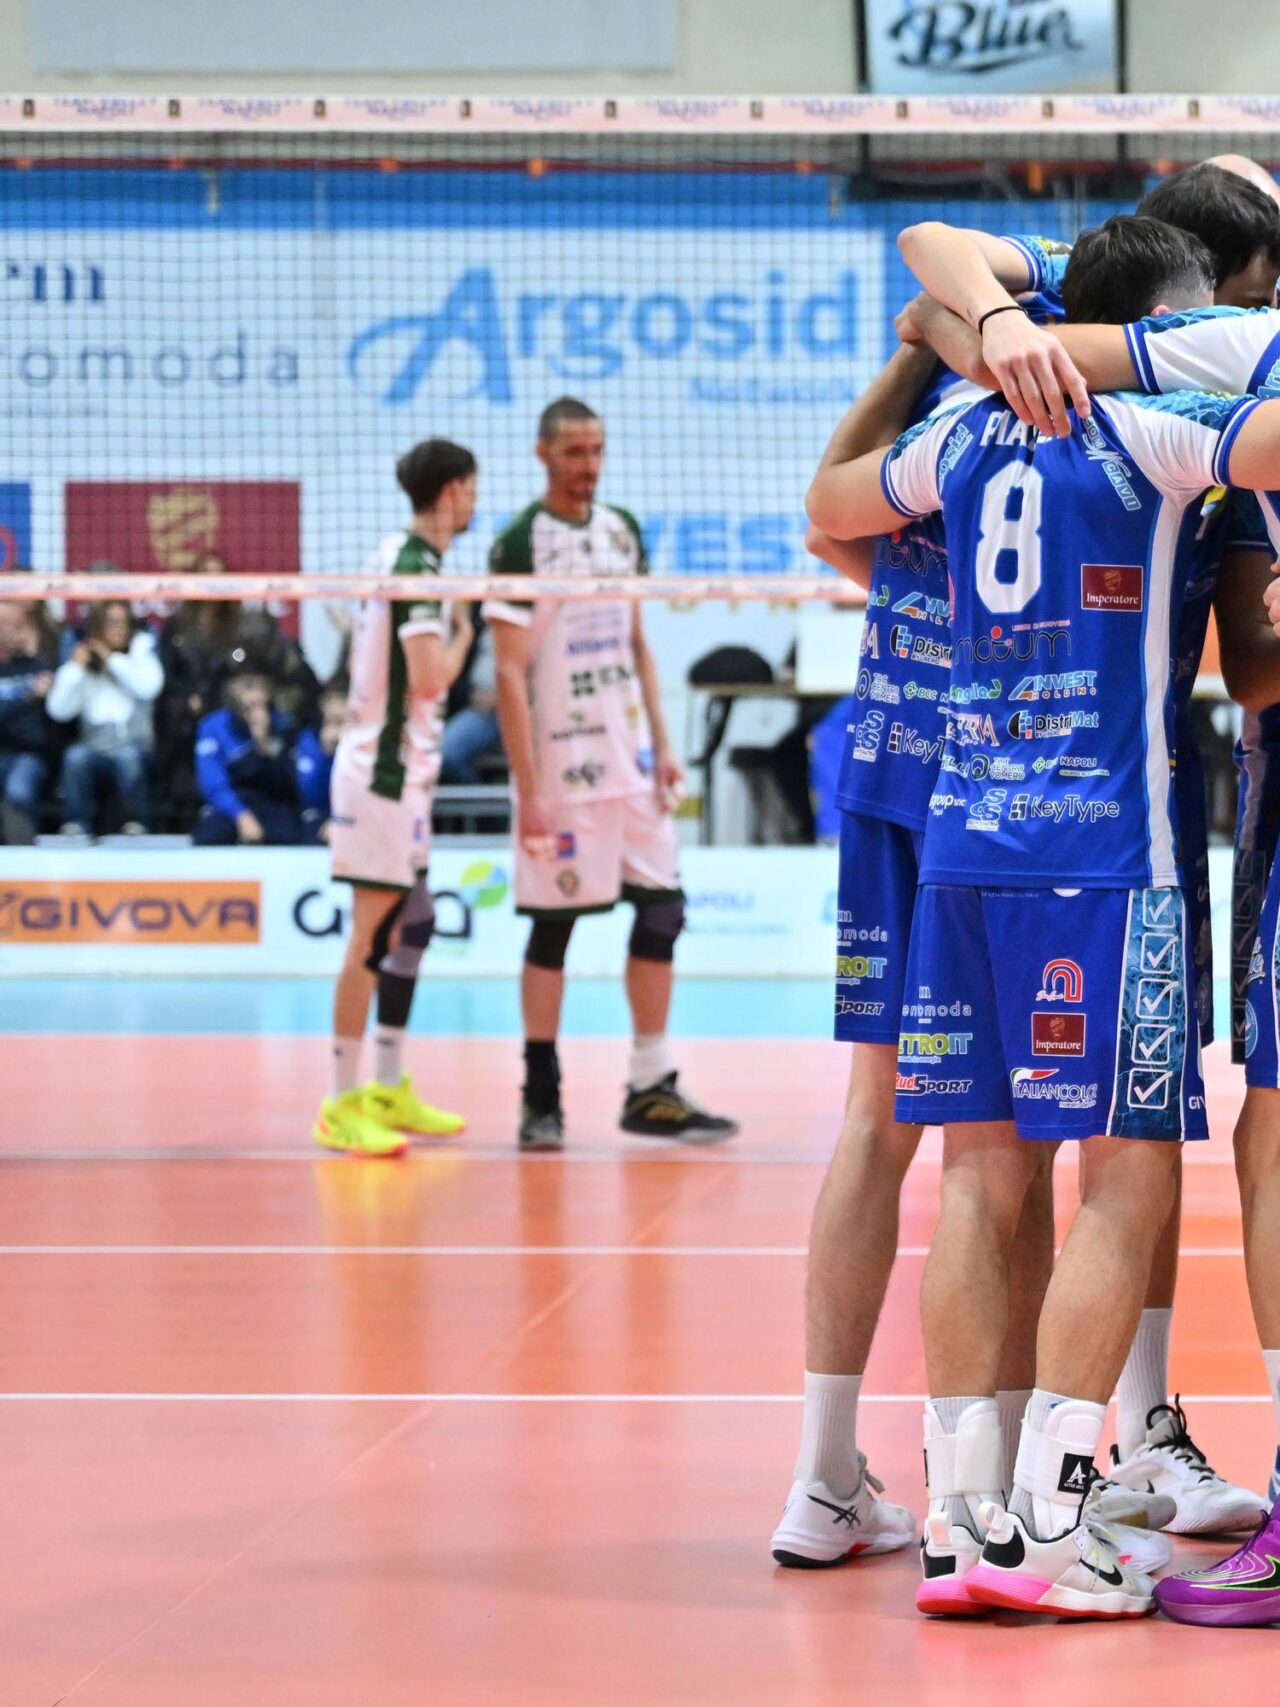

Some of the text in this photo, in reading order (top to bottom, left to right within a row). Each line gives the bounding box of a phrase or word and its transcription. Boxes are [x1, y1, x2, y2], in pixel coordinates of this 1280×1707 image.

[347, 267, 857, 406] Argosid
[975, 460, 1044, 614] 8
[1086, 592, 1140, 606] Imperatore
[1033, 671, 1097, 692] INVEST
[1034, 711, 1099, 731] DistriMat
[1060, 756, 1097, 768] NAPOLI
[1031, 795, 1120, 823] KeyType
[20, 898, 259, 931] GIVOVA
[1036, 1039, 1081, 1053] Imperatore
